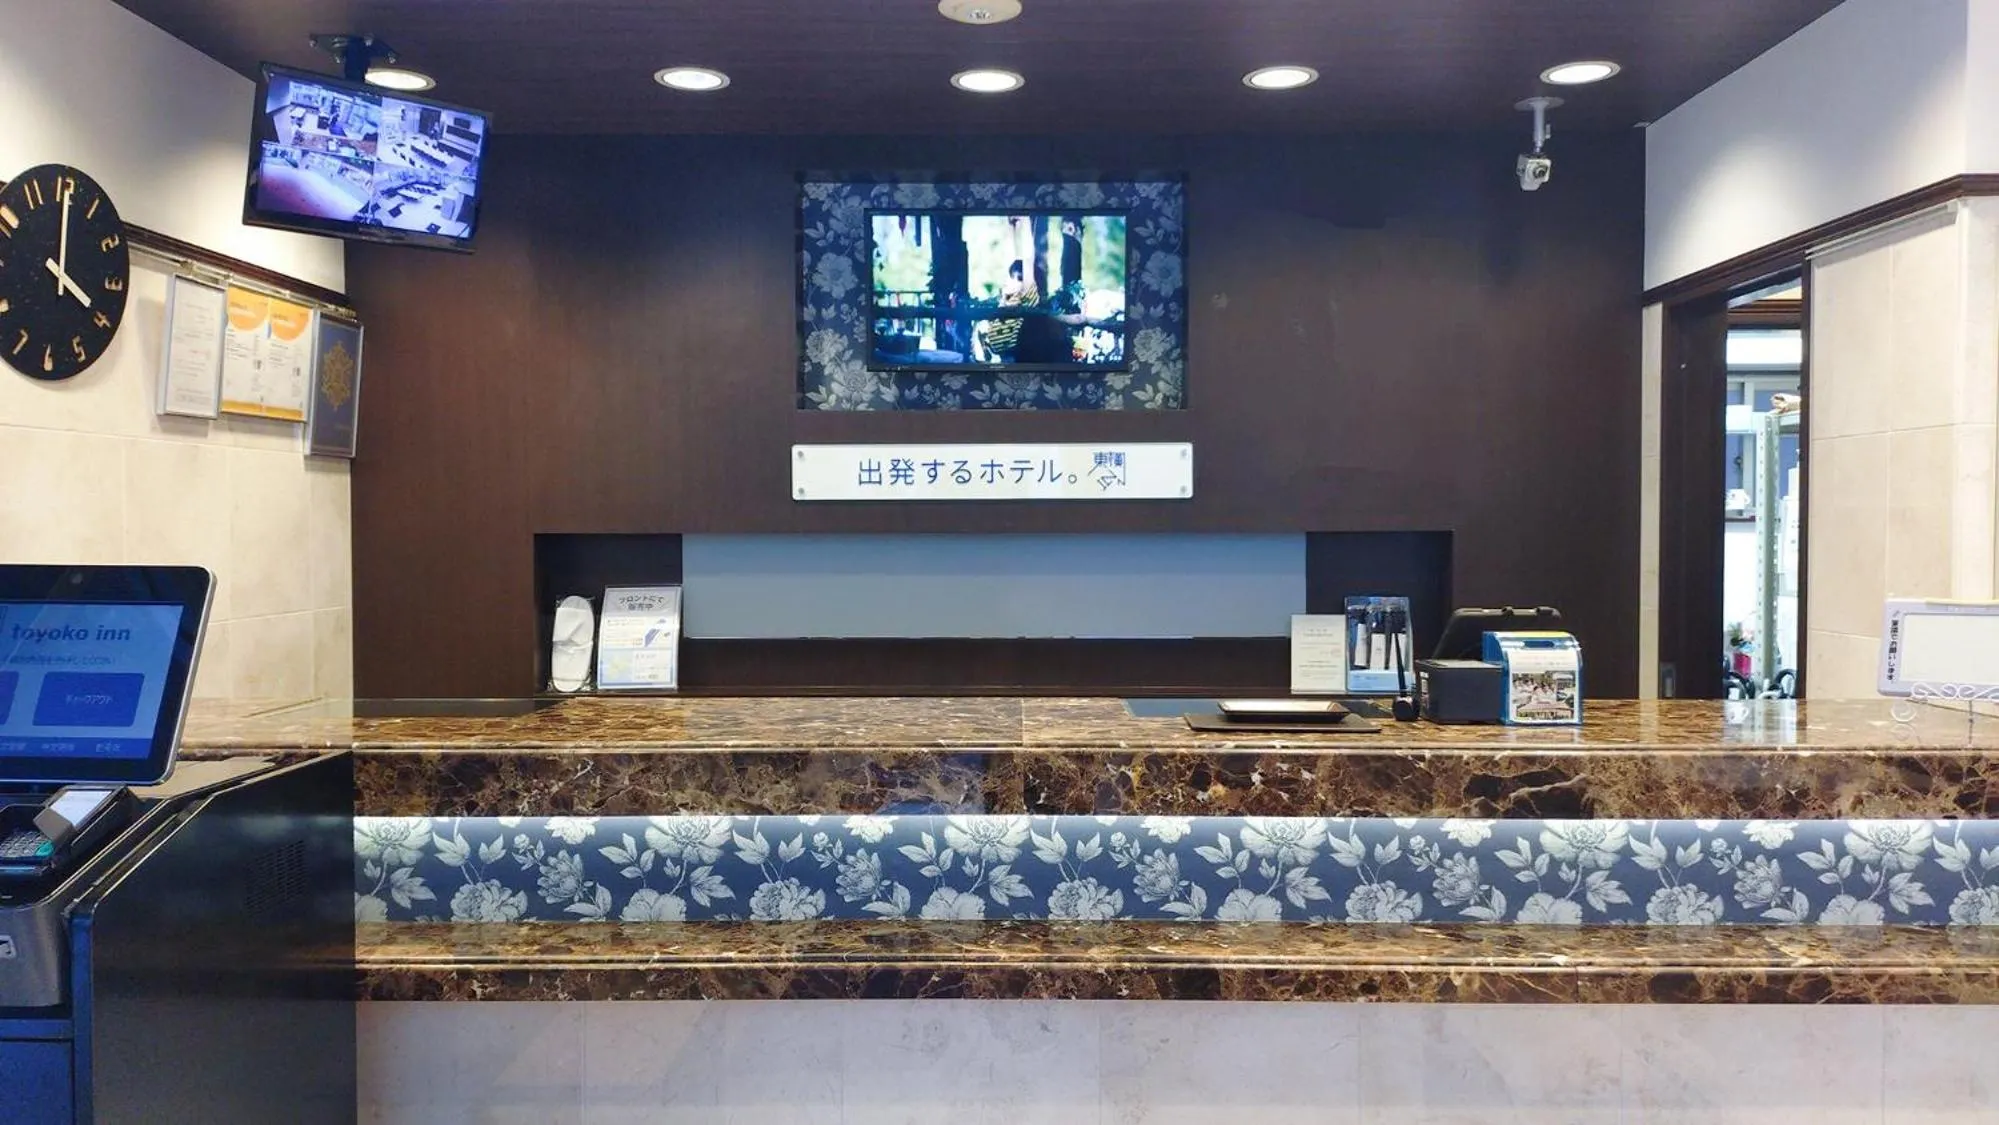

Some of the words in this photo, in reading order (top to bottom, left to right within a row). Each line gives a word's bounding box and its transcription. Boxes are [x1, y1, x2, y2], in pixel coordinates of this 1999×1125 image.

[24, 178, 44, 210] 11
[86, 197, 100, 219] 1
[101, 233, 120, 252] 2
[104, 275, 123, 291] 3
[93, 310, 111, 328] 4
[13, 328, 29, 355] 7
[72, 335, 86, 362] 5
[43, 343, 53, 371] 6
[857, 457, 1078, 486] 出発するホテル。
[10, 622, 89, 643] toyoko
[95, 624, 131, 641] inn
